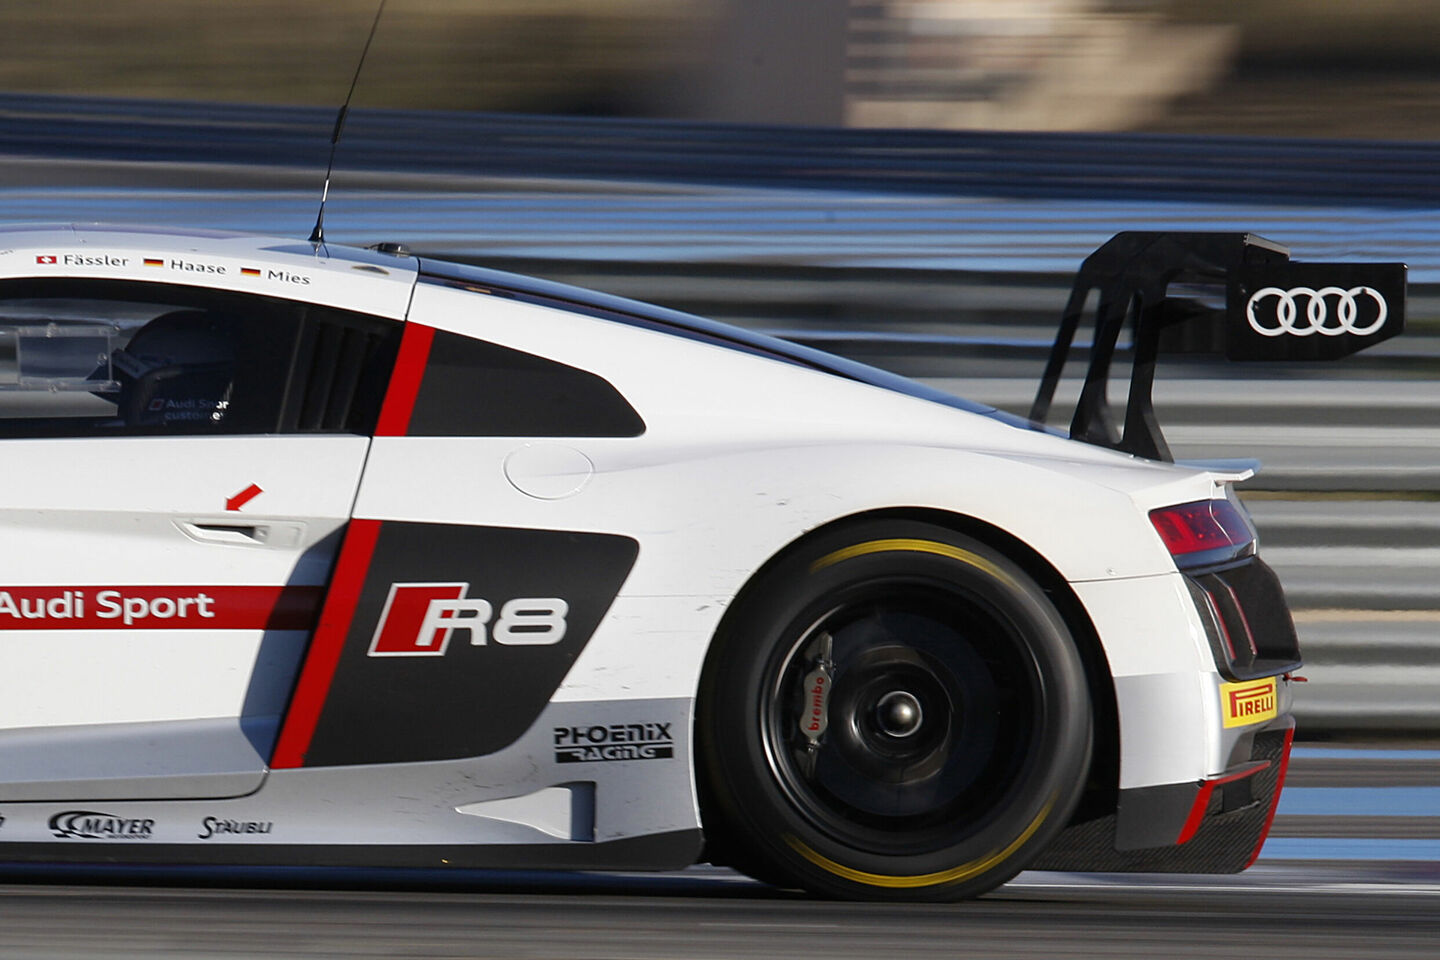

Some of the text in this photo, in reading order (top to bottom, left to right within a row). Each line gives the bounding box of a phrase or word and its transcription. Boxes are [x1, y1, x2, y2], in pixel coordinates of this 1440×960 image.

[64, 254, 311, 285] Fässler Haase Mies
[166, 399, 195, 409] Audi
[95, 589, 216, 625] Sport
[415, 597, 569, 647] R8
[808, 676, 825, 731] brembo
[1229, 683, 1274, 718] PIRELLI
[81, 818, 155, 834] MAYER
